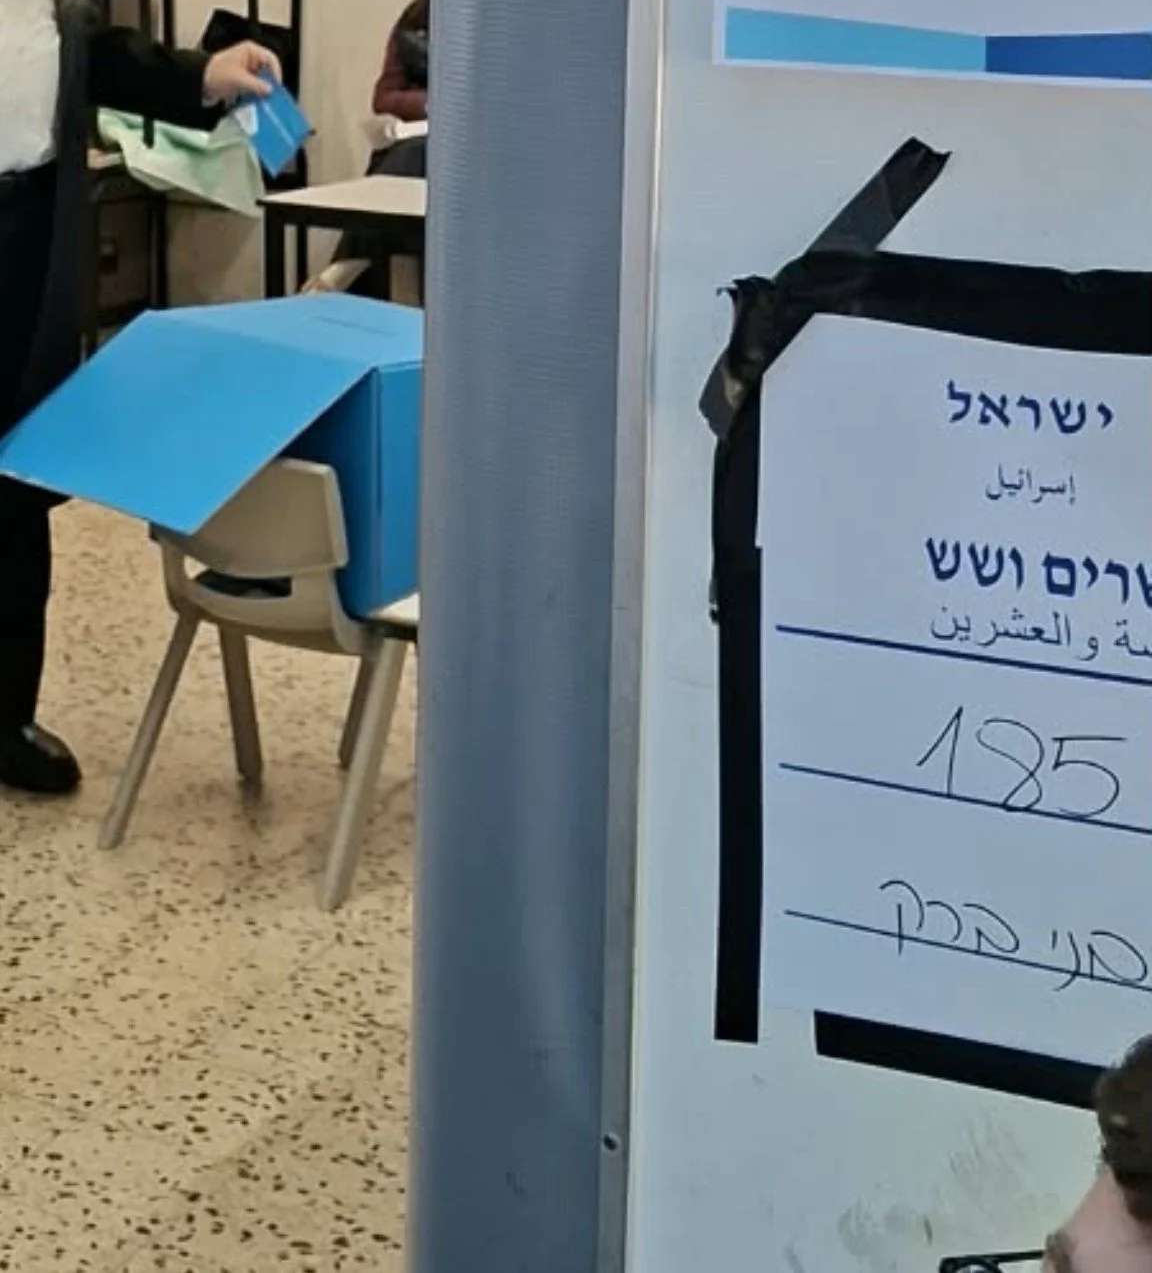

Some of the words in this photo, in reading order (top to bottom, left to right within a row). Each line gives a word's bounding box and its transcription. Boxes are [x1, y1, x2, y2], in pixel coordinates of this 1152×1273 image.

[947, 379, 1115, 434] ישראל
[985, 464, 1076, 505] إسرائيل
[925, 537, 1026, 590] ושש
[915, 705, 1128, 820] 185
